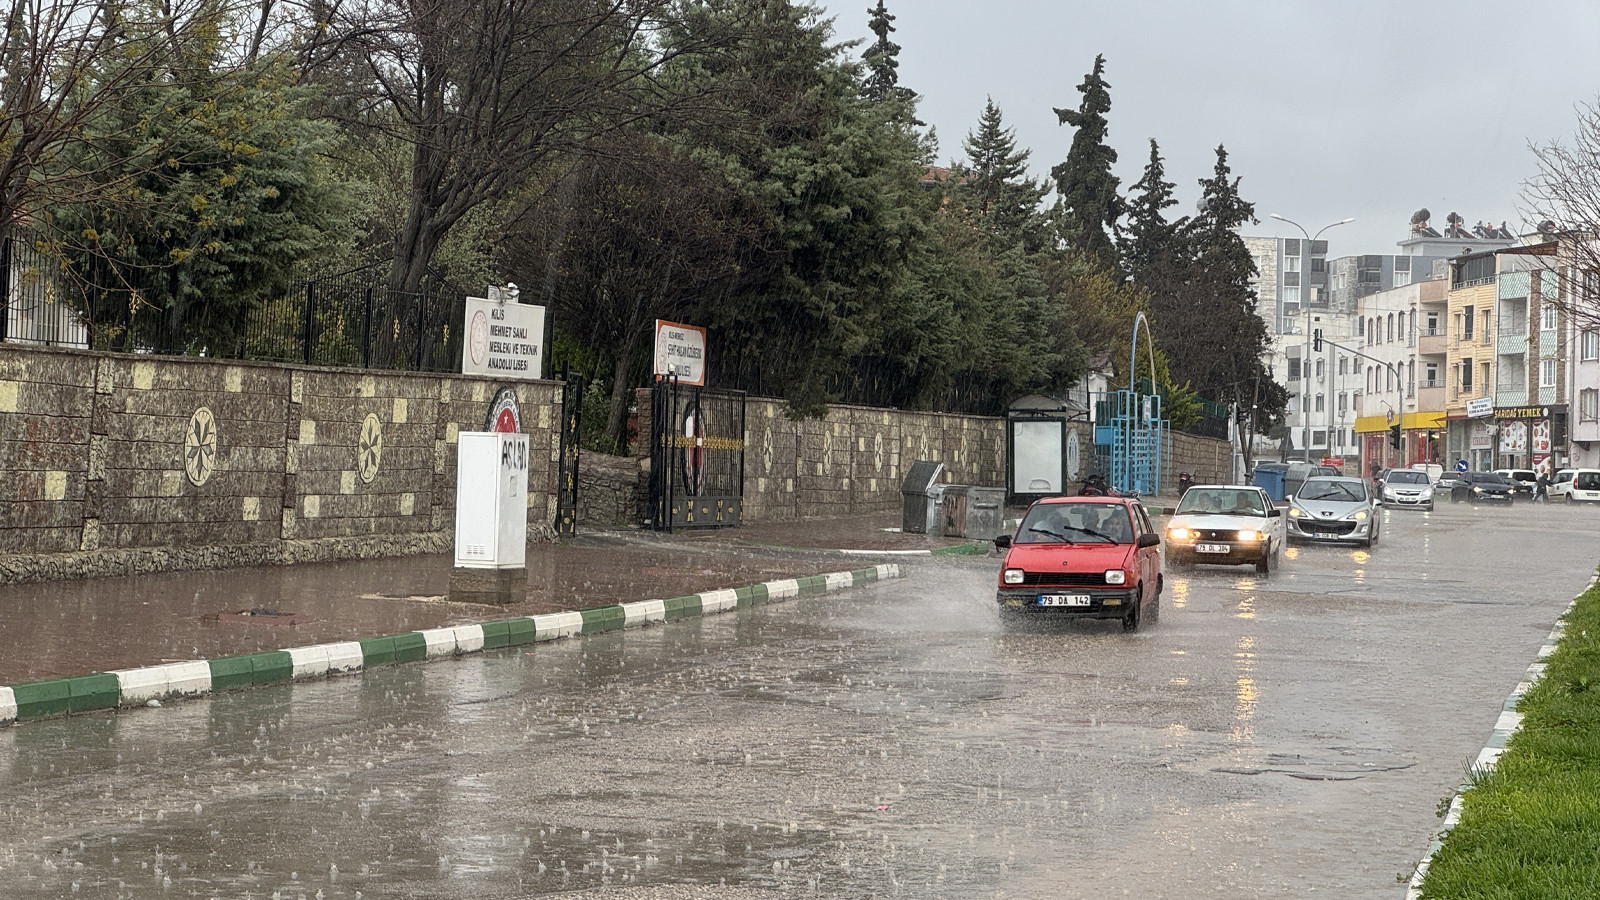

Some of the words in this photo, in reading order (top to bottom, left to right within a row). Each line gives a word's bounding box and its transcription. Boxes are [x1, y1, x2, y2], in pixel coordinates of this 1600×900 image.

[491, 308, 505, 321] KİLİS
[490, 325, 512, 338] MEHMET
[512, 327, 528, 339] SANLI
[489, 341, 512, 354] MESLEKİ
[512, 343, 519, 355] VE
[520, 344, 538, 356] TEKNİK
[488, 357, 512, 370] ANADOLU
[513, 360, 528, 371] LİSESİ
[1518, 408, 1541, 418] YEMEK
[1043, 596, 1053, 604] 79
[1058, 596, 1068, 604] DA
[1075, 596, 1089, 604] 142
